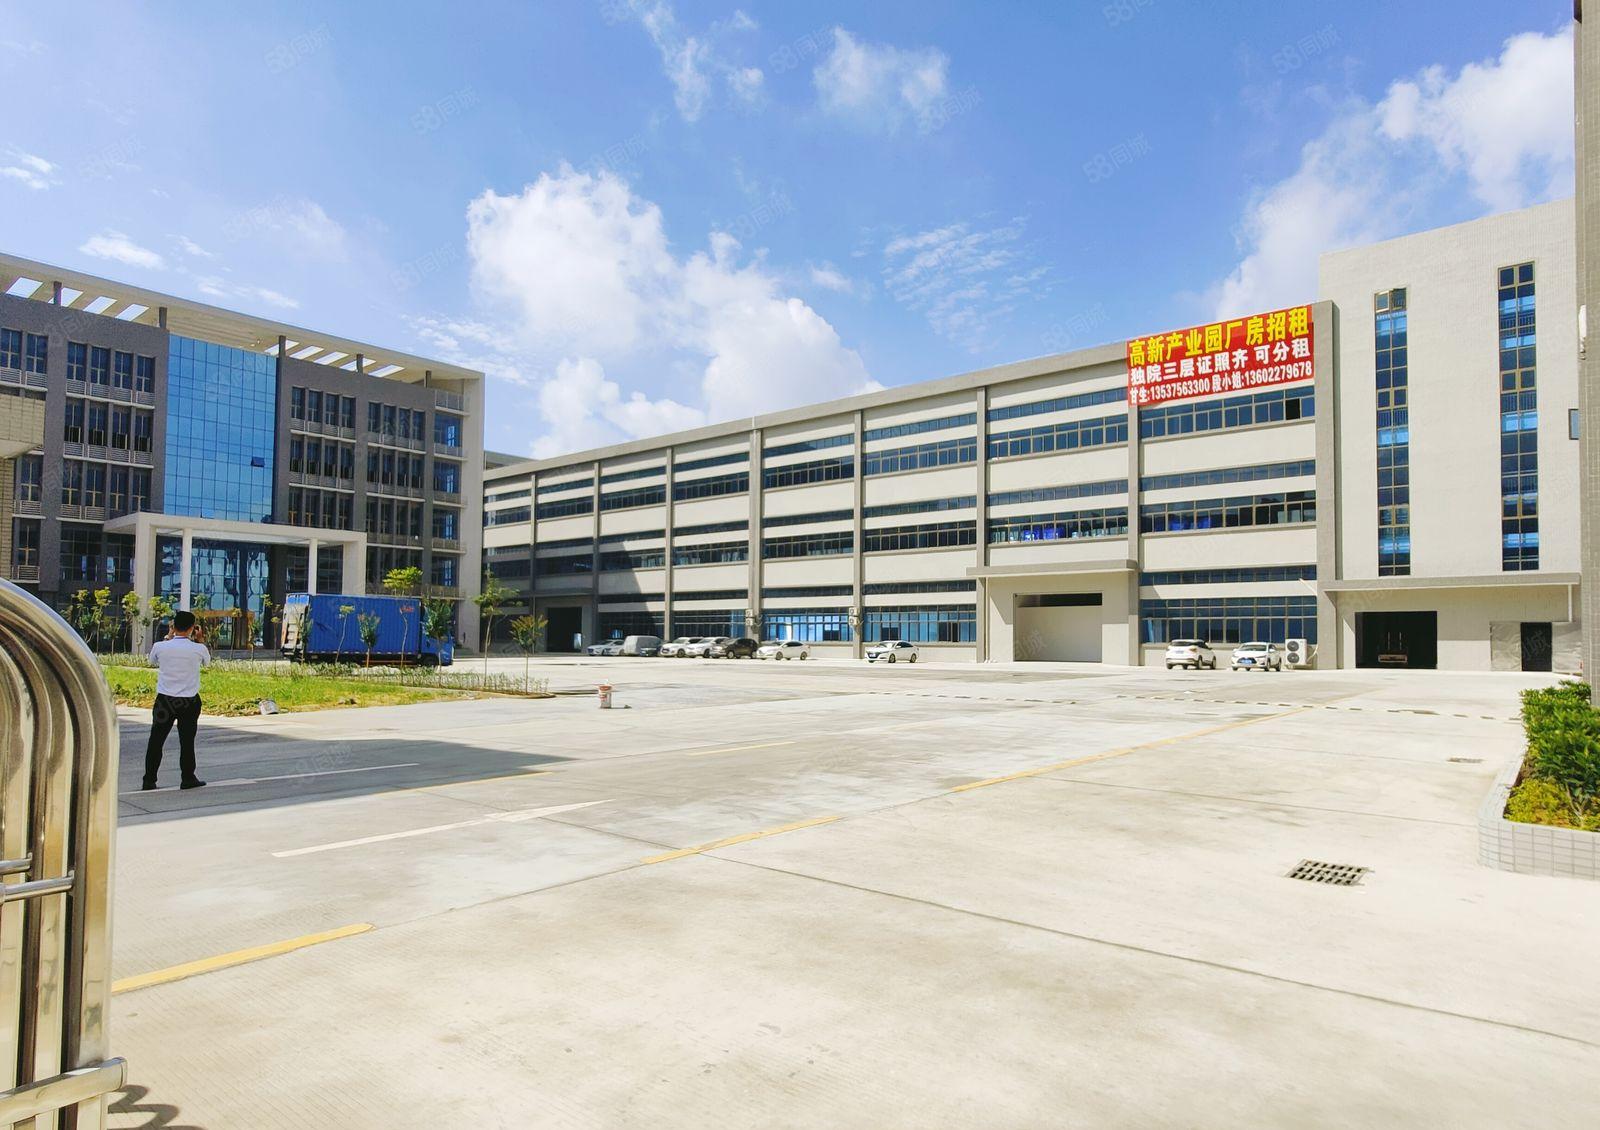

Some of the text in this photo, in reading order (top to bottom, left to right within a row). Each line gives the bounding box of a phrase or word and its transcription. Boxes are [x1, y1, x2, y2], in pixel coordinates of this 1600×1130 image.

[1129, 306, 1310, 366] 高新产业园厂房招租
[1130, 337, 1311, 386] 独院三层证照齐 可分租
[1212, 360, 1313, 393] 段小姐:13602279678
